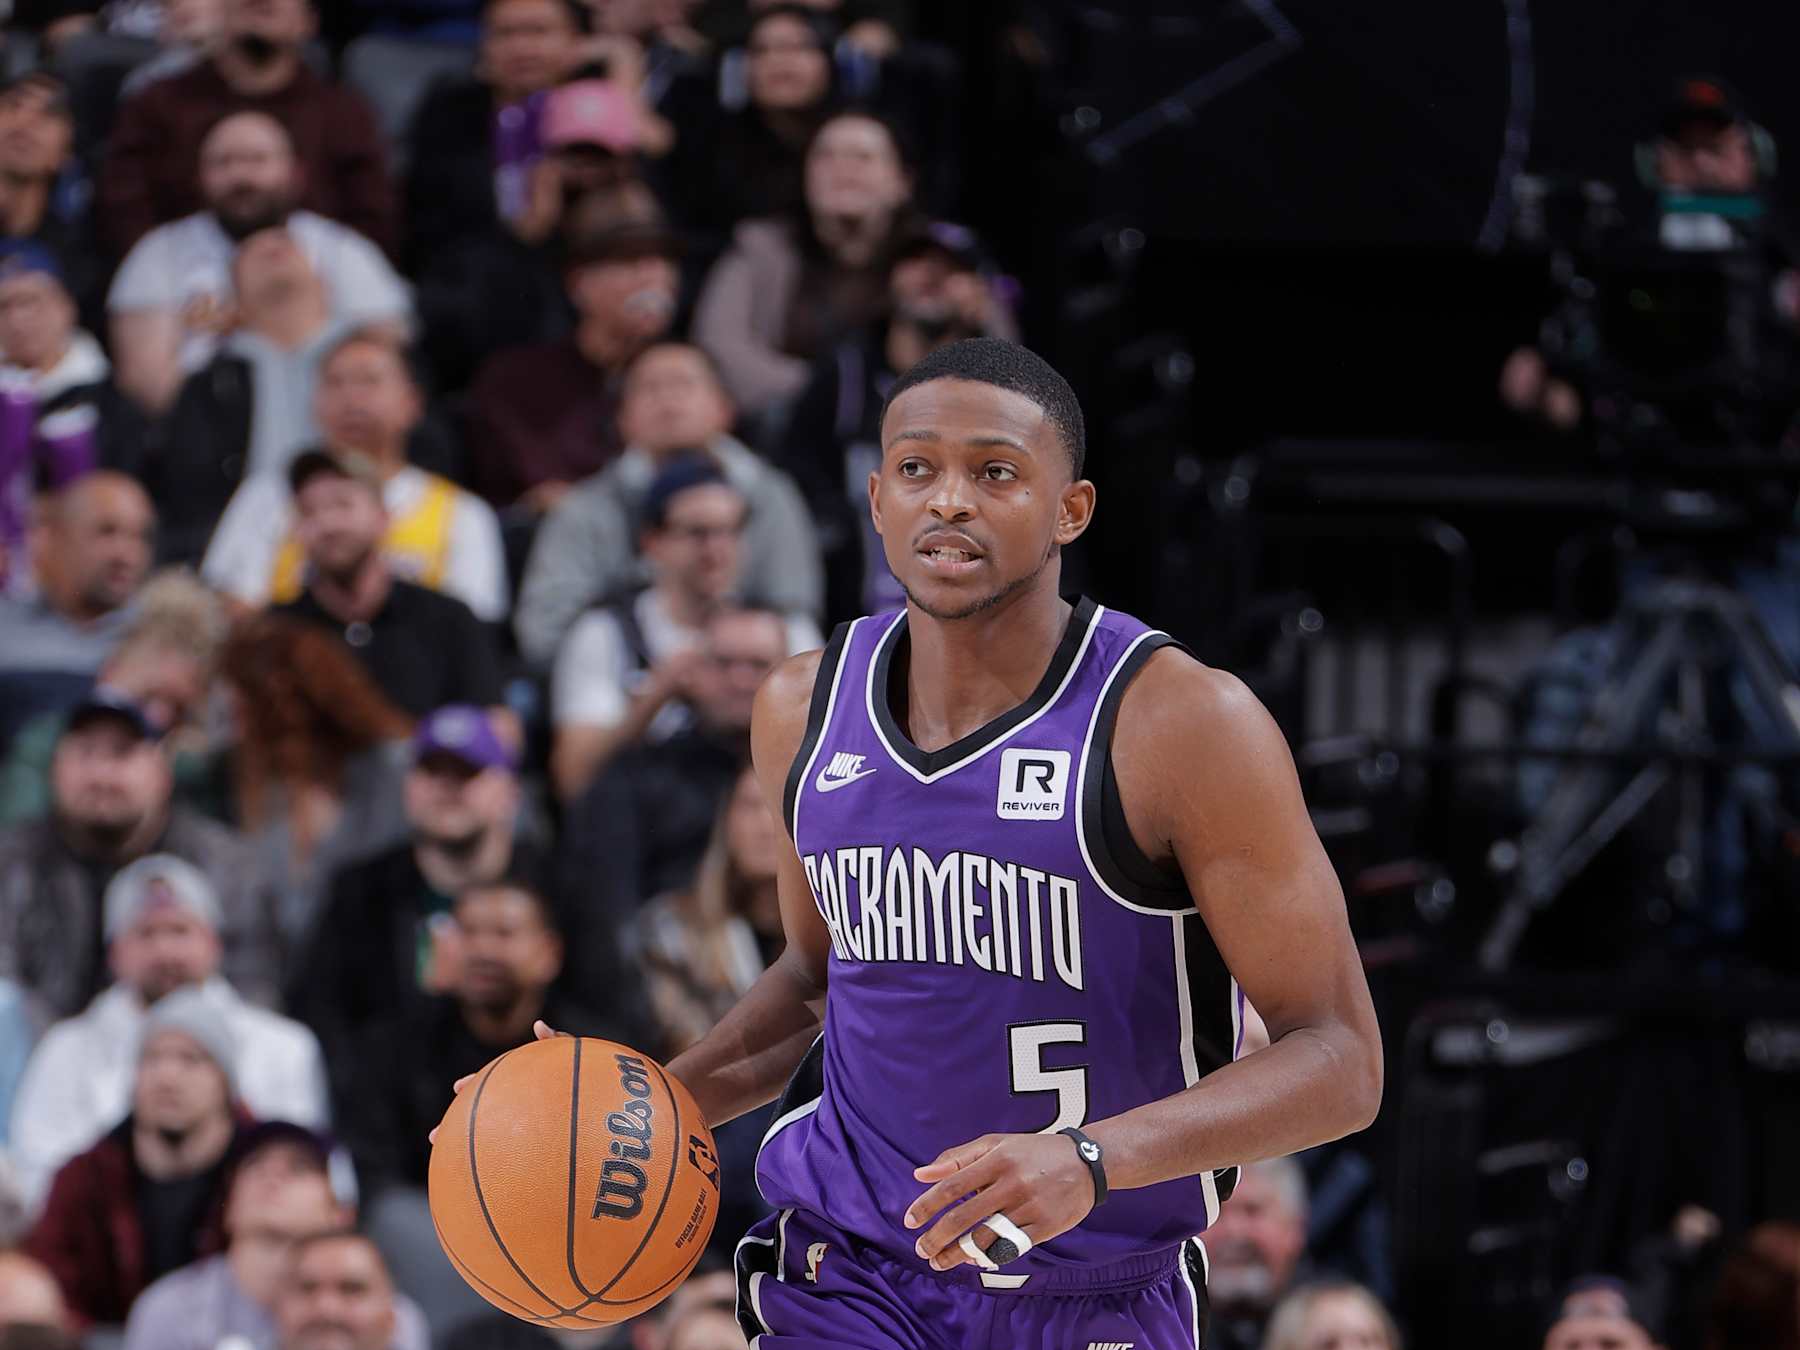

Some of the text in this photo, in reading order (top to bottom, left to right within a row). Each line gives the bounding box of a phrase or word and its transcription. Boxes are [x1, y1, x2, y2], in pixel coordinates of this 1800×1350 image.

[825, 751, 867, 779] NIKE
[1015, 758, 1055, 793] R
[1002, 802, 1060, 811] REVIVER
[803, 846, 1084, 991] SACRAMENTO
[1008, 1020, 1088, 1135] 5
[592, 1053, 655, 1221] Wilson
